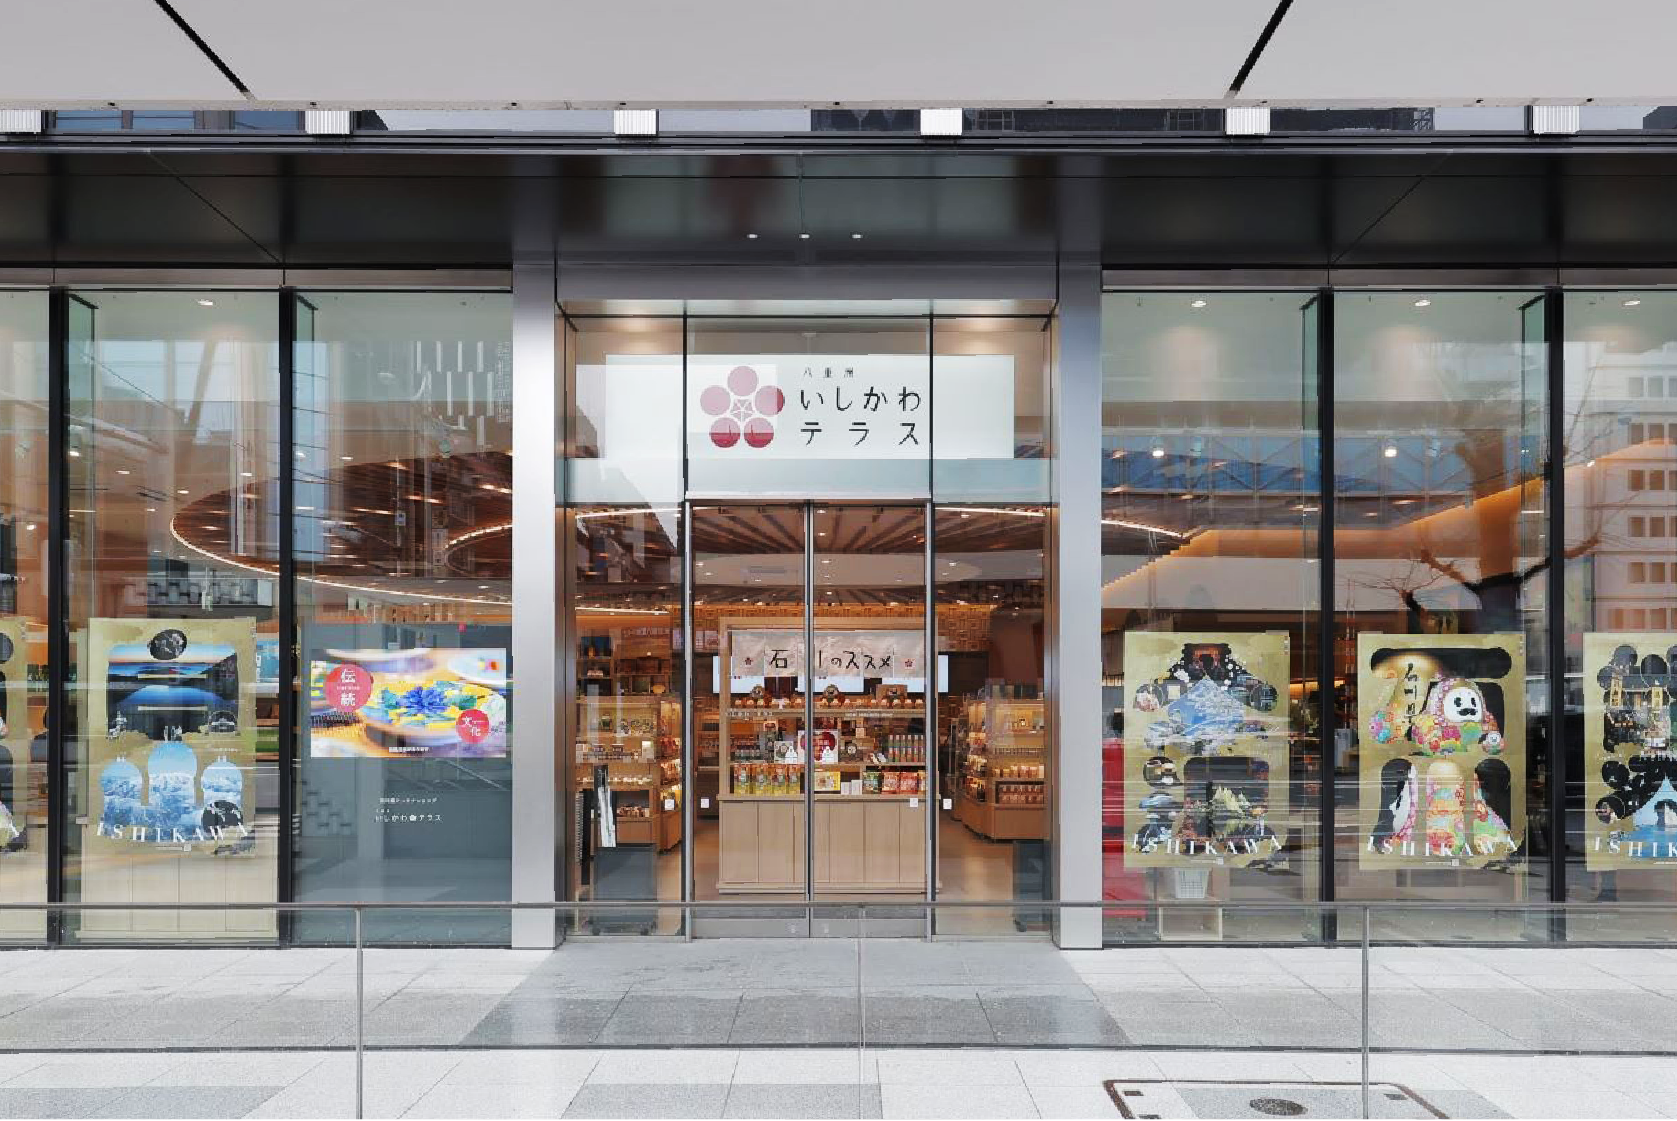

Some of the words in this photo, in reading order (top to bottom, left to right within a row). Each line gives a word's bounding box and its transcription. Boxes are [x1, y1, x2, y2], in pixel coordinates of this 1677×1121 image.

[800, 385, 922, 412] いしかわ
[800, 421, 919, 446] テラス
[96, 821, 249, 843] ISHIKAWA
[1133, 833, 1283, 855] ISHIKAWA
[1367, 835, 1519, 857] ISHIKAWA
